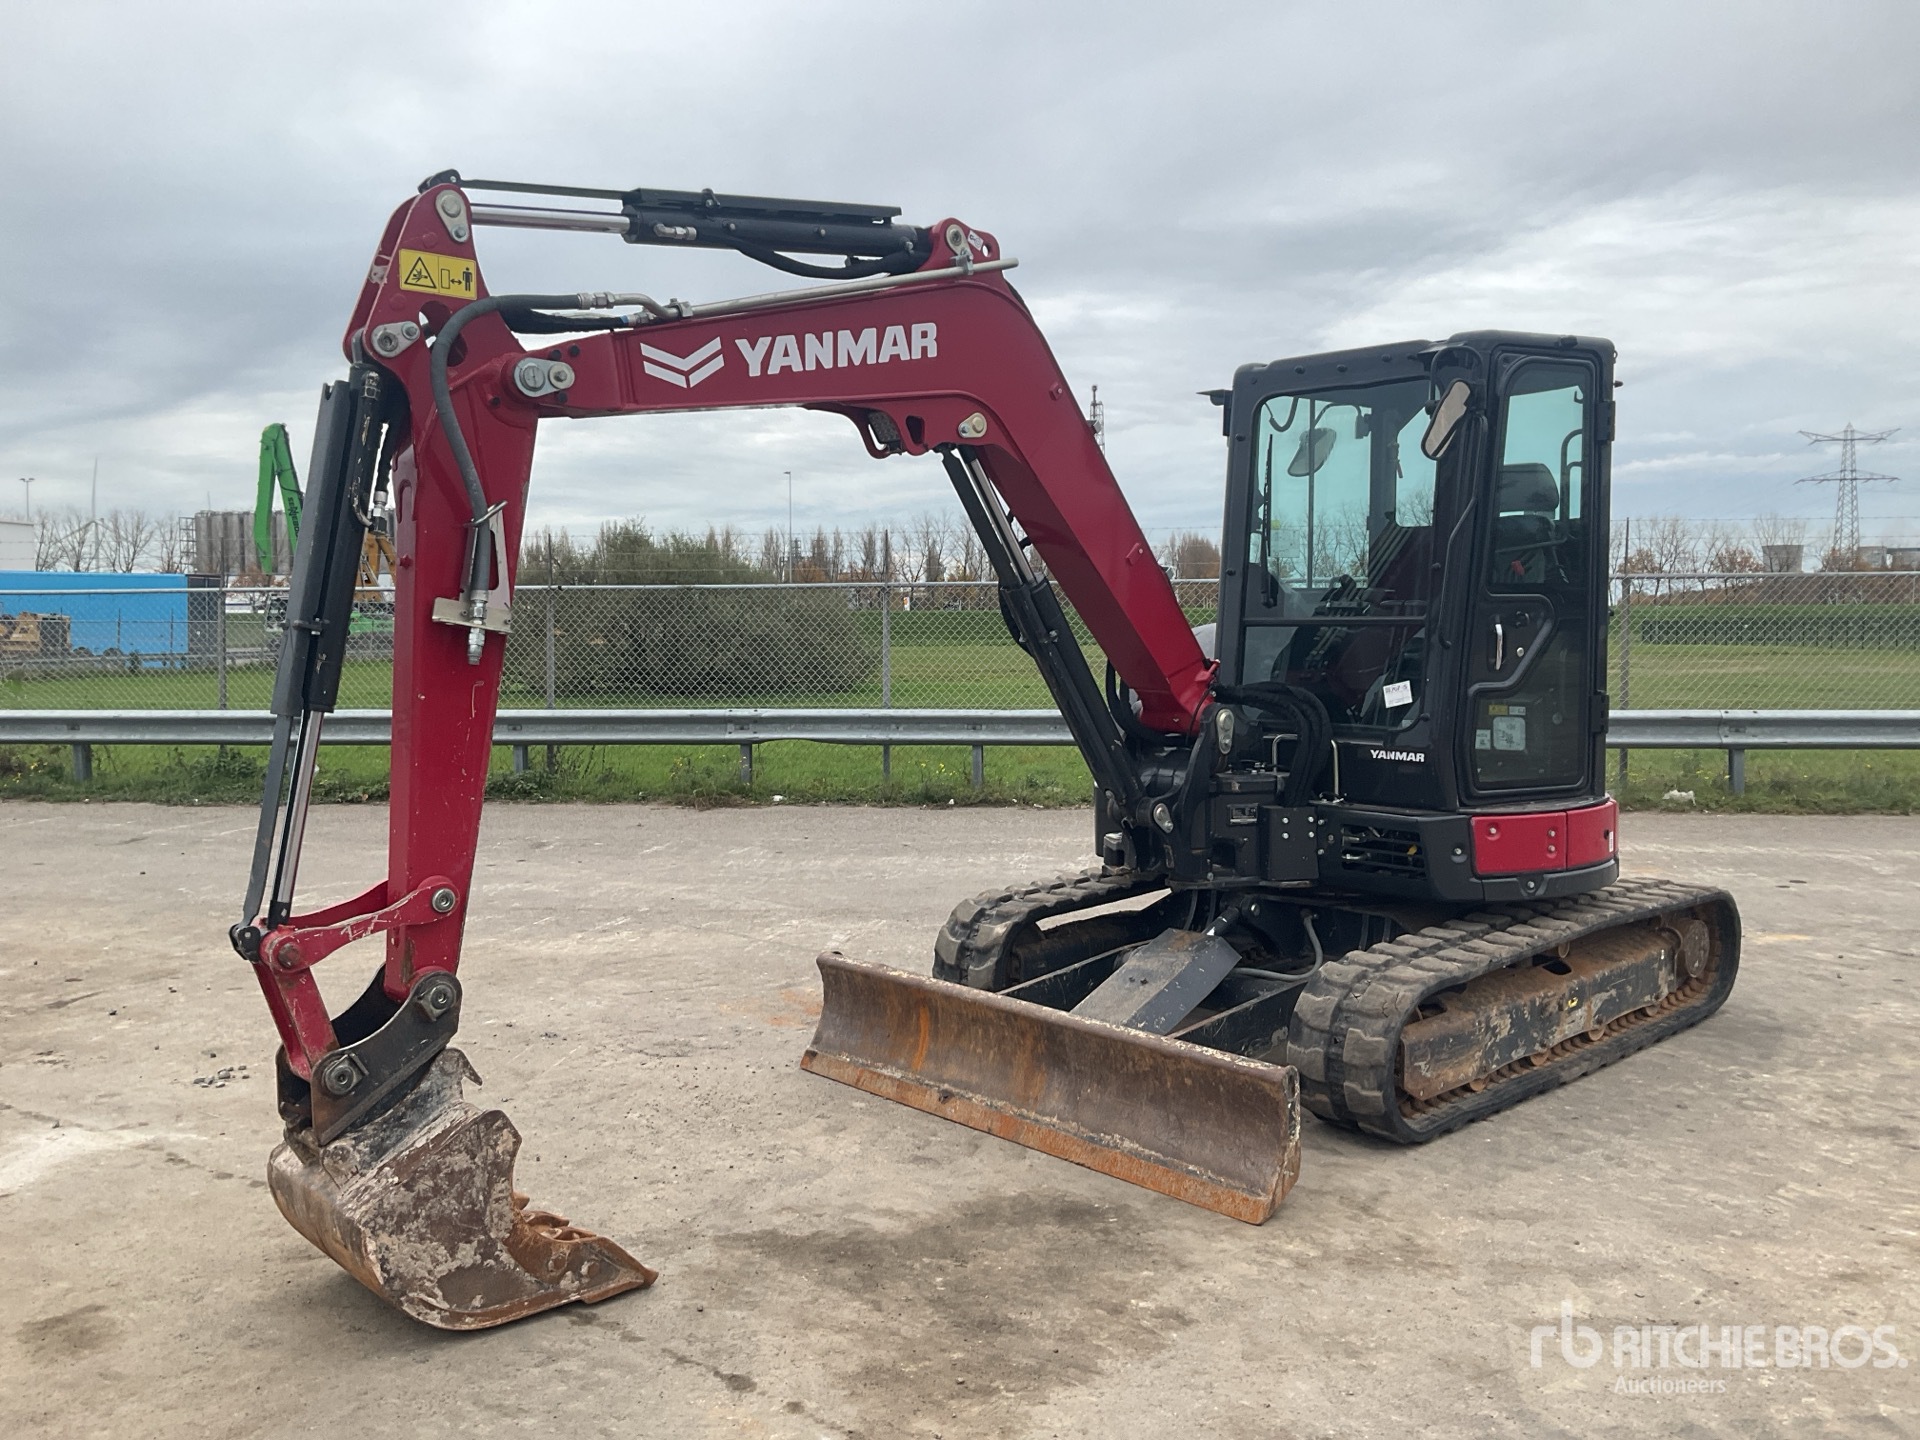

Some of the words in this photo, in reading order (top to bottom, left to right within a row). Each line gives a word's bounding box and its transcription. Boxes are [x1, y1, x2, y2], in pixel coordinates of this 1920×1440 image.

[734, 322, 938, 377] YANMAR
[288, 497, 300, 538] SENNEBO
[1370, 749, 1425, 763] YANMAR
